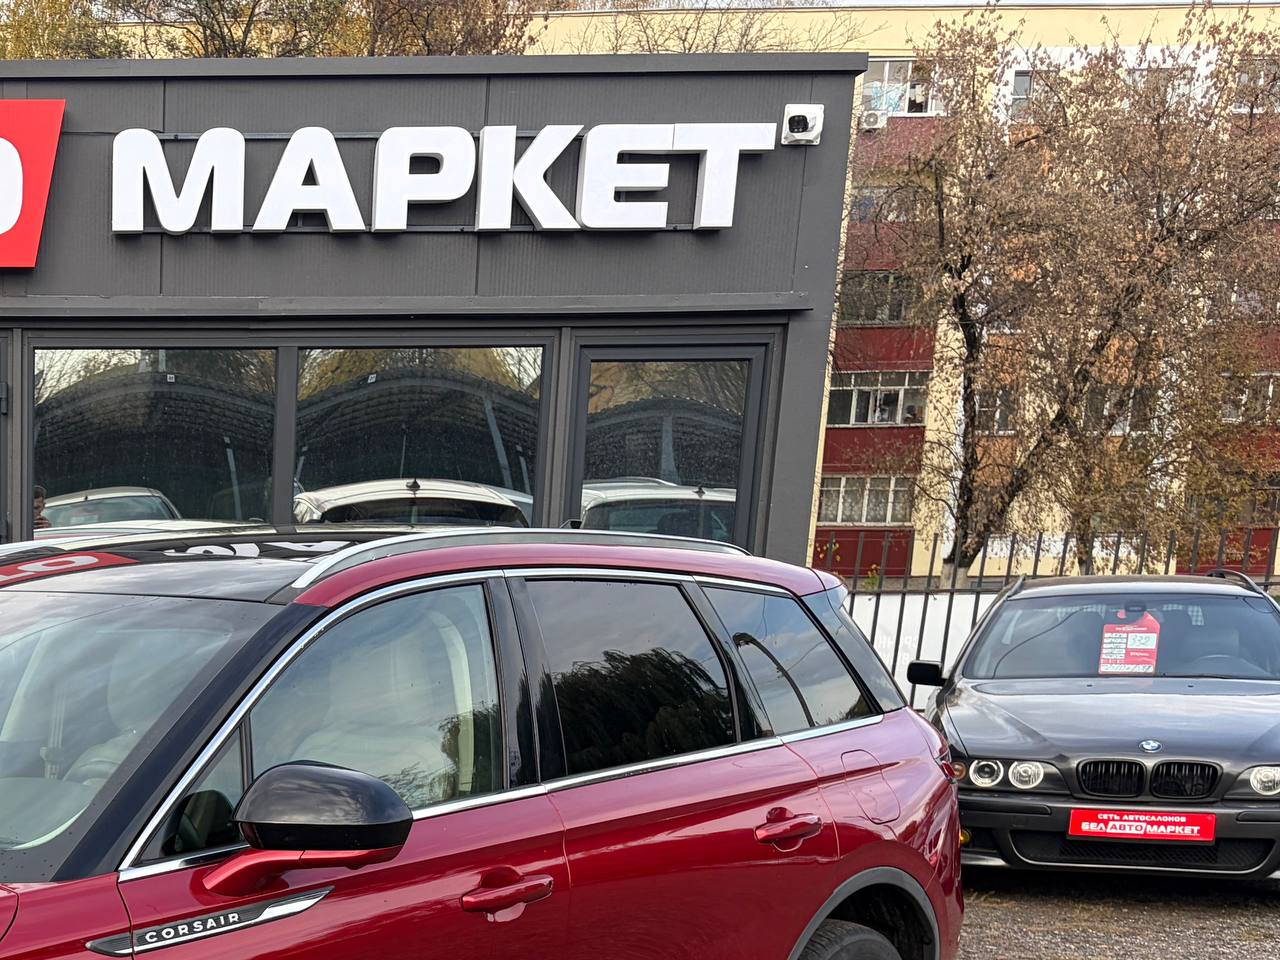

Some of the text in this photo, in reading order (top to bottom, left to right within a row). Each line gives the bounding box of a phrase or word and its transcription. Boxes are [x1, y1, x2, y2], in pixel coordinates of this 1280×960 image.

[111, 122, 777, 236] МАРКЕТ
[1081, 822, 1200, 834] БЕЛ АВТО МАРКЕТ
[1122, 814, 1186, 822] АВТОСАЛОНОВ
[145, 912, 240, 943] CORSAIR
